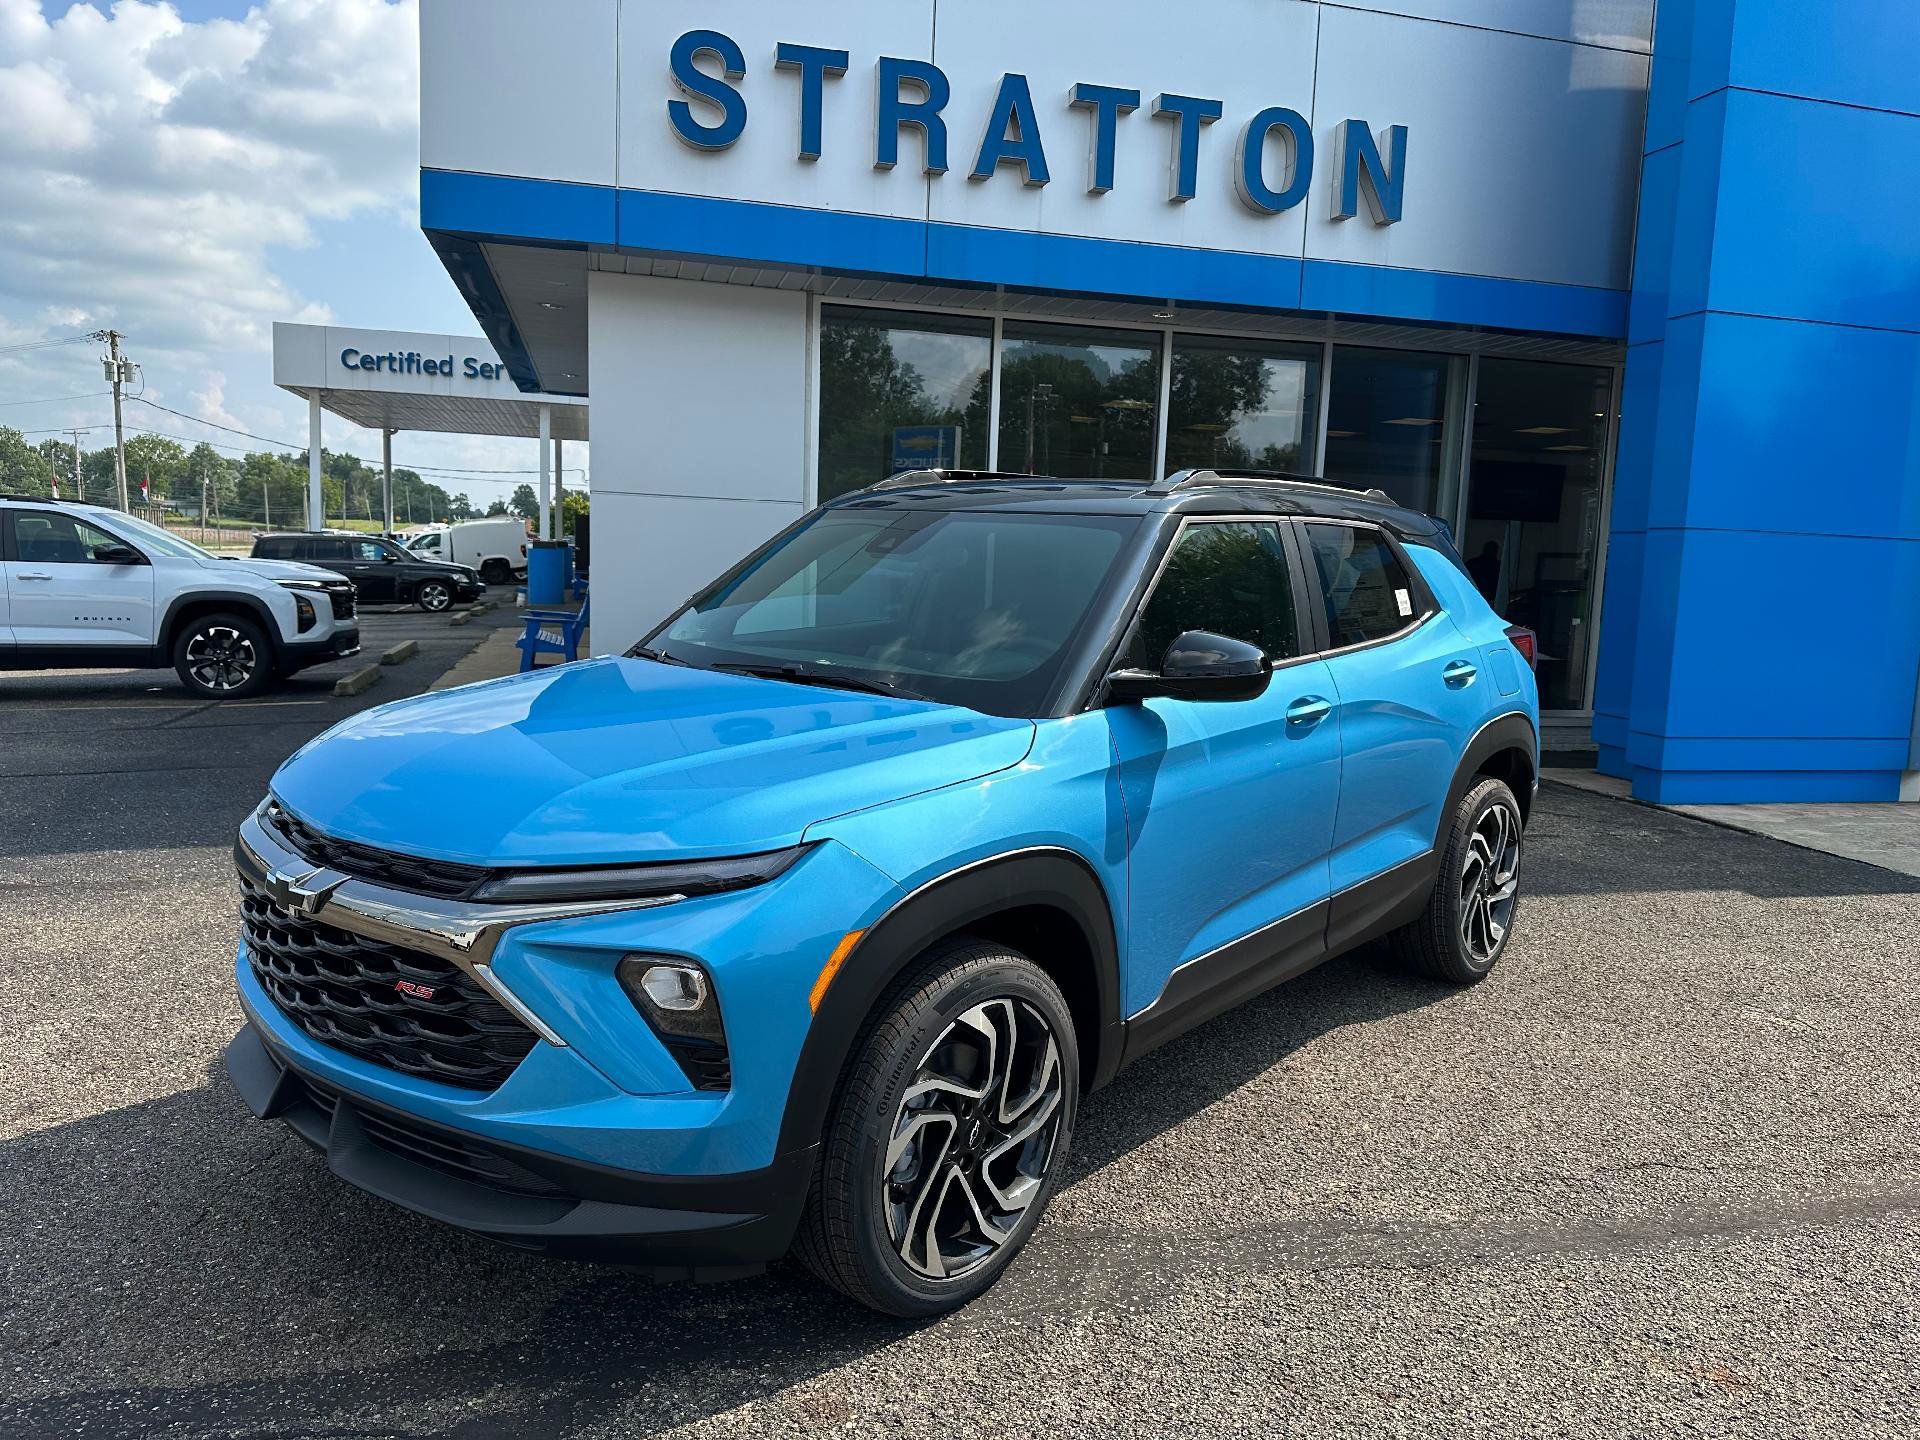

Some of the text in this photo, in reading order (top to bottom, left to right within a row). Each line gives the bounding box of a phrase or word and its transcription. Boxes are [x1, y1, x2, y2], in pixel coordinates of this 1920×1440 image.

[667, 28, 1409, 226] STRATTON
[340, 348, 506, 380] Certified Ser
[394, 980, 434, 999] RS
[877, 1033, 922, 1117] Continental
